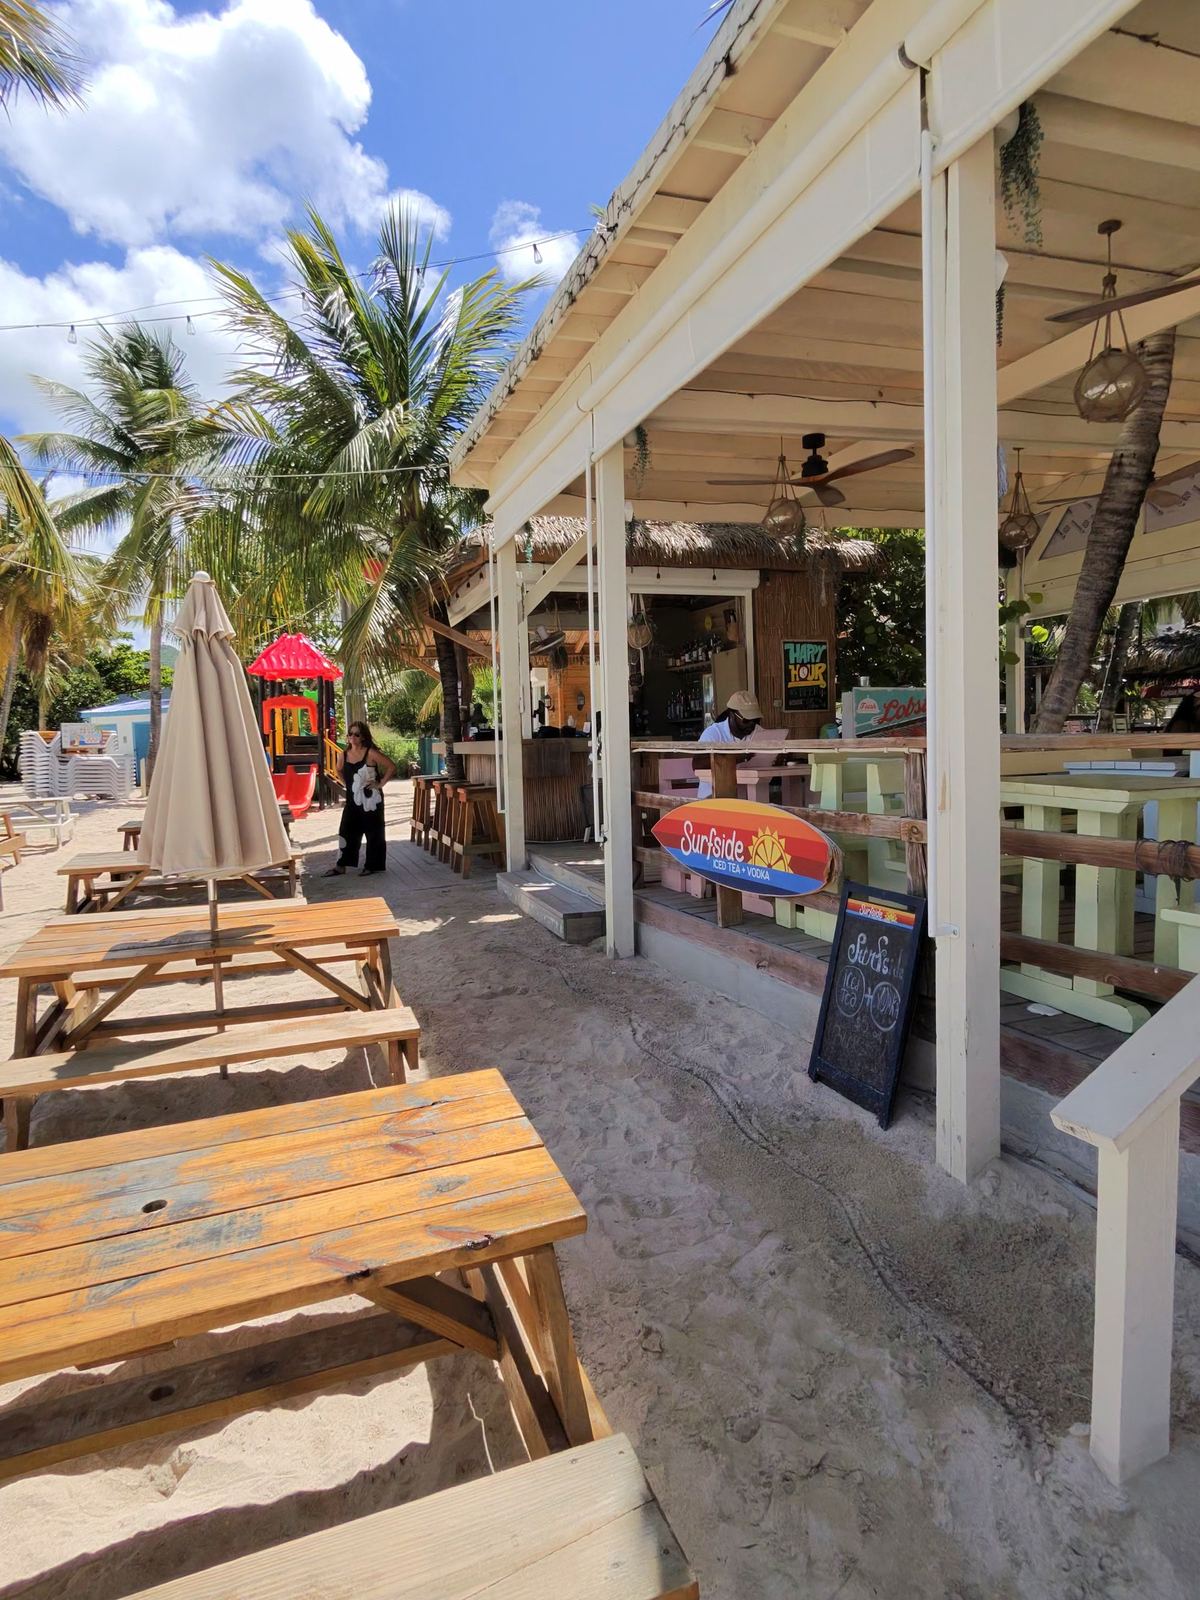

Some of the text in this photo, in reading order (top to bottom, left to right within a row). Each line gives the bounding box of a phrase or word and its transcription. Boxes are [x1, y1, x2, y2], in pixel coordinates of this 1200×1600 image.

[784, 643, 827, 664] HAPPY
[788, 662, 827, 687] HOUR
[680, 820, 745, 863] Surfside
[712, 859, 727, 871] ICED
[727, 862, 741, 874] TEA
[746, 866, 770, 881] VODKA
